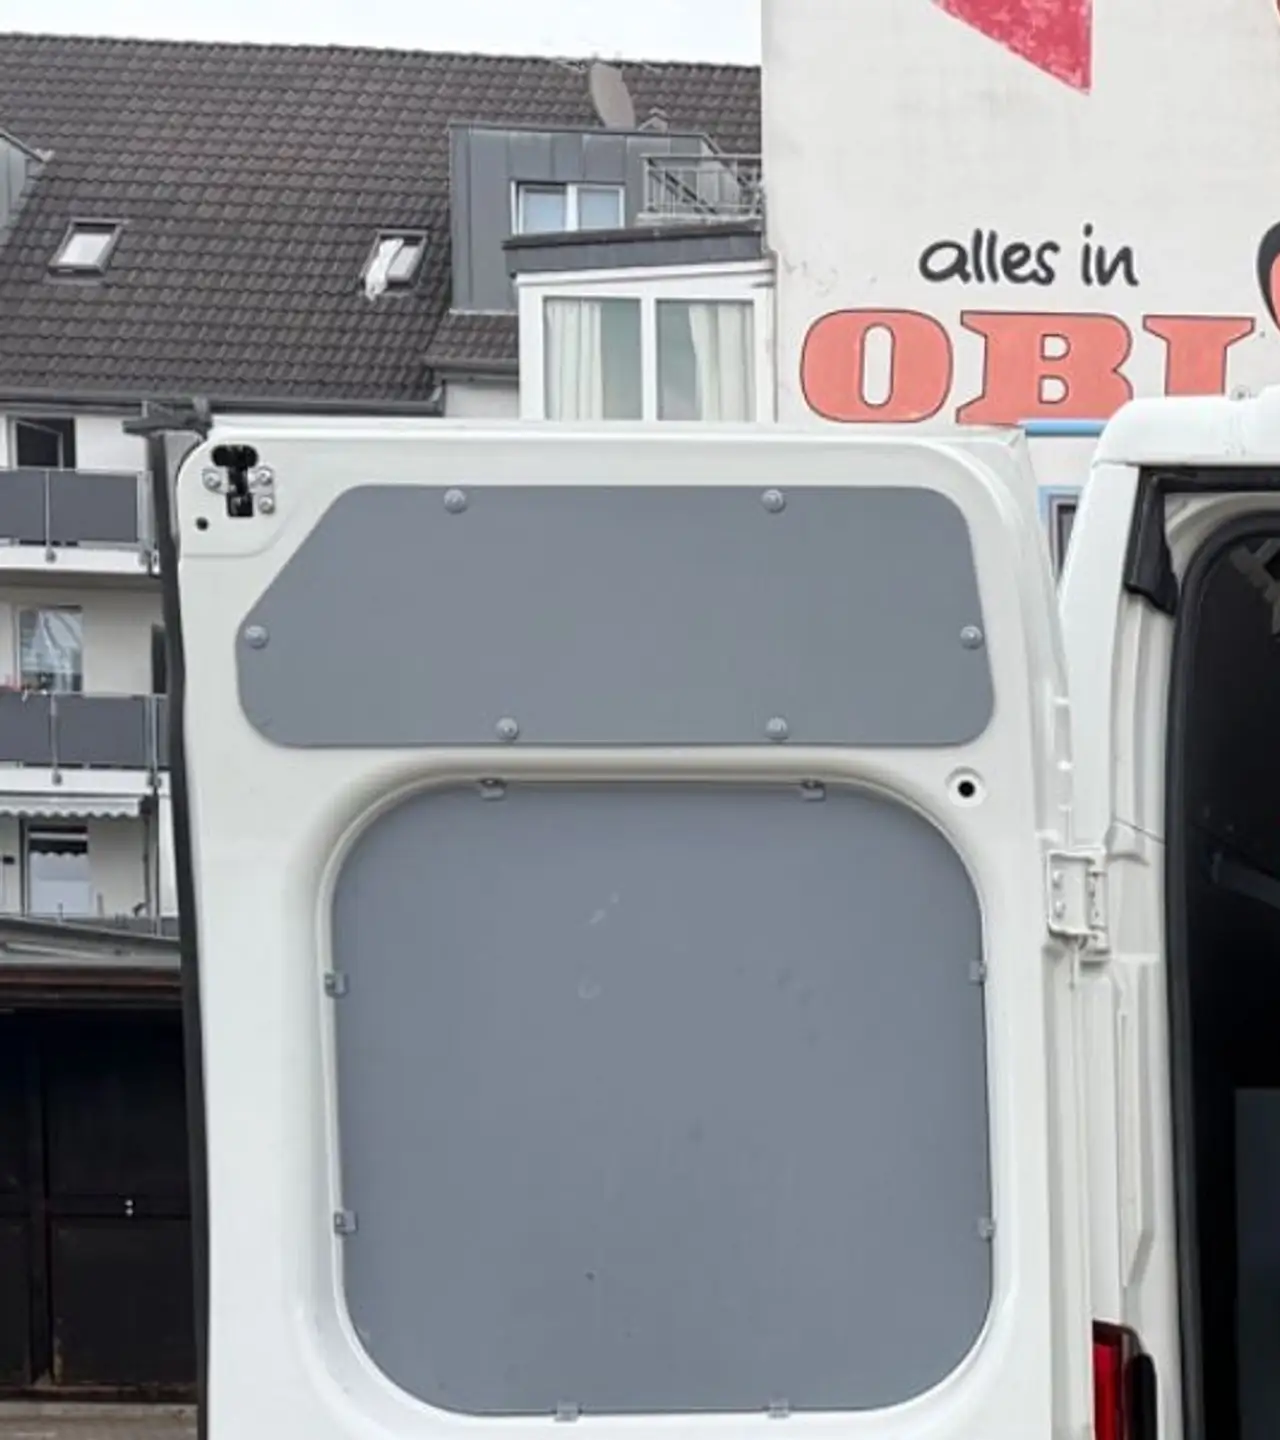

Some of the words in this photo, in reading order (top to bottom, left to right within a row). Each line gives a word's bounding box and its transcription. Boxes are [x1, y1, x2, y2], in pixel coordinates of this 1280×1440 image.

[918, 228, 1060, 287] alles
[1080, 223, 1140, 288] in
[800, 308, 1256, 425] OBI
